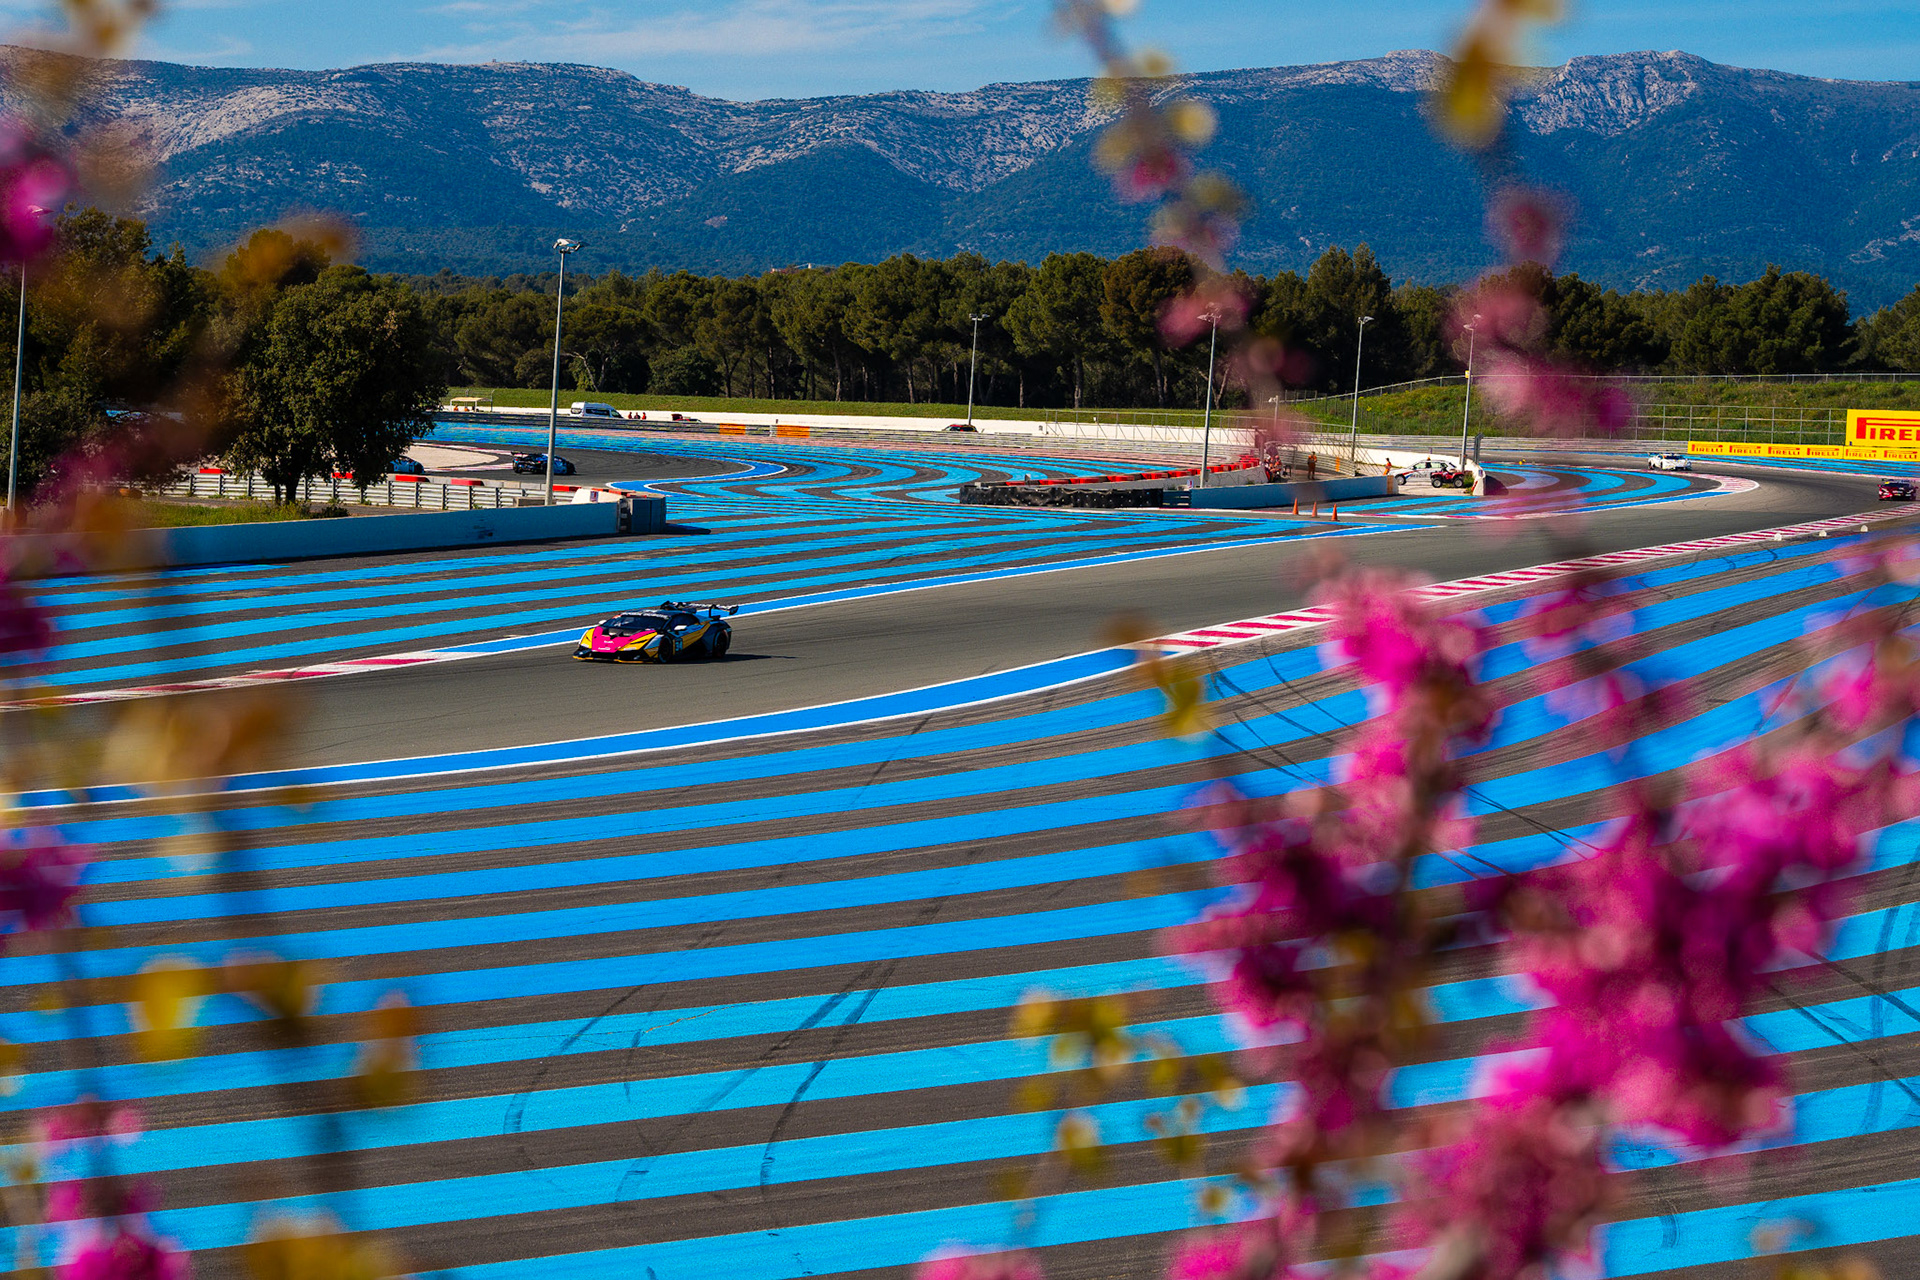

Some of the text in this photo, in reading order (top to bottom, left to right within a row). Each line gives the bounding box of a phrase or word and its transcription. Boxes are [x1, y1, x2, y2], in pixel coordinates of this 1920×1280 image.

[1692, 444, 1839, 456] PIRELLI PIRELLI PIRELLI PIRELLI
[1845, 449, 1917, 459] PIRELLI PIRELLI
